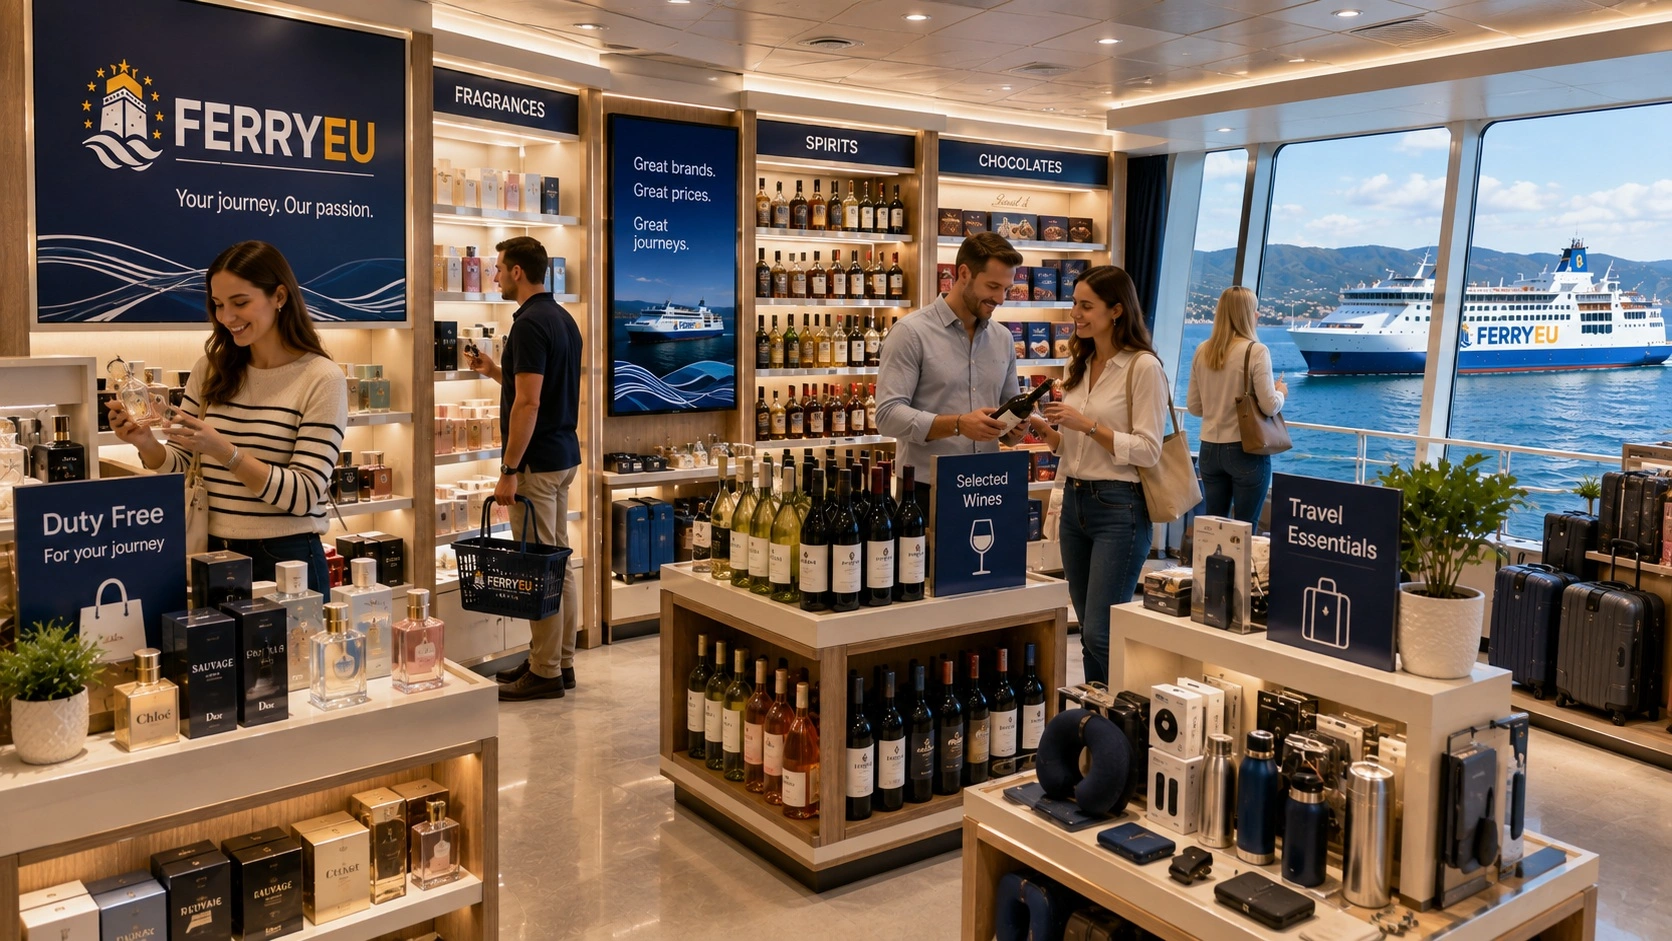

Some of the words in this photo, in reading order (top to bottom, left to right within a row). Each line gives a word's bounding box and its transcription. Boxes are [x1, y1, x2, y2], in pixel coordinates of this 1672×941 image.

[455, 85, 546, 119] FRAGRANCES
[175, 97, 375, 164] FERRYEU
[806, 135, 858, 154] SPIRITS
[633, 156, 669, 173] Great
[671, 159, 716, 177] brands.
[979, 153, 1063, 174] CHOCOLATES
[633, 182, 669, 199] Great
[671, 186, 711, 203] prices.
[175, 188, 214, 209] Your
[216, 191, 280, 217] journey.
[284, 195, 312, 215] Our
[315, 199, 374, 220] passion.
[633, 216, 669, 232] Great
[632, 234, 690, 253] journeys.
[1477, 325, 1559, 345] FERRYEU
[956, 471, 1009, 489] Selected
[962, 492, 1003, 508] Wines
[43, 511, 104, 537] Duty
[112, 505, 164, 528] Free
[1288, 497, 1343, 525] Travel
[44, 548, 69, 564] For
[73, 545, 108, 564] your
[110, 538, 165, 559] journey
[1287, 525, 1378, 560] Essentials
[487, 575, 533, 592] FERRYEU
[192, 658, 234, 674] SAUVAGE
